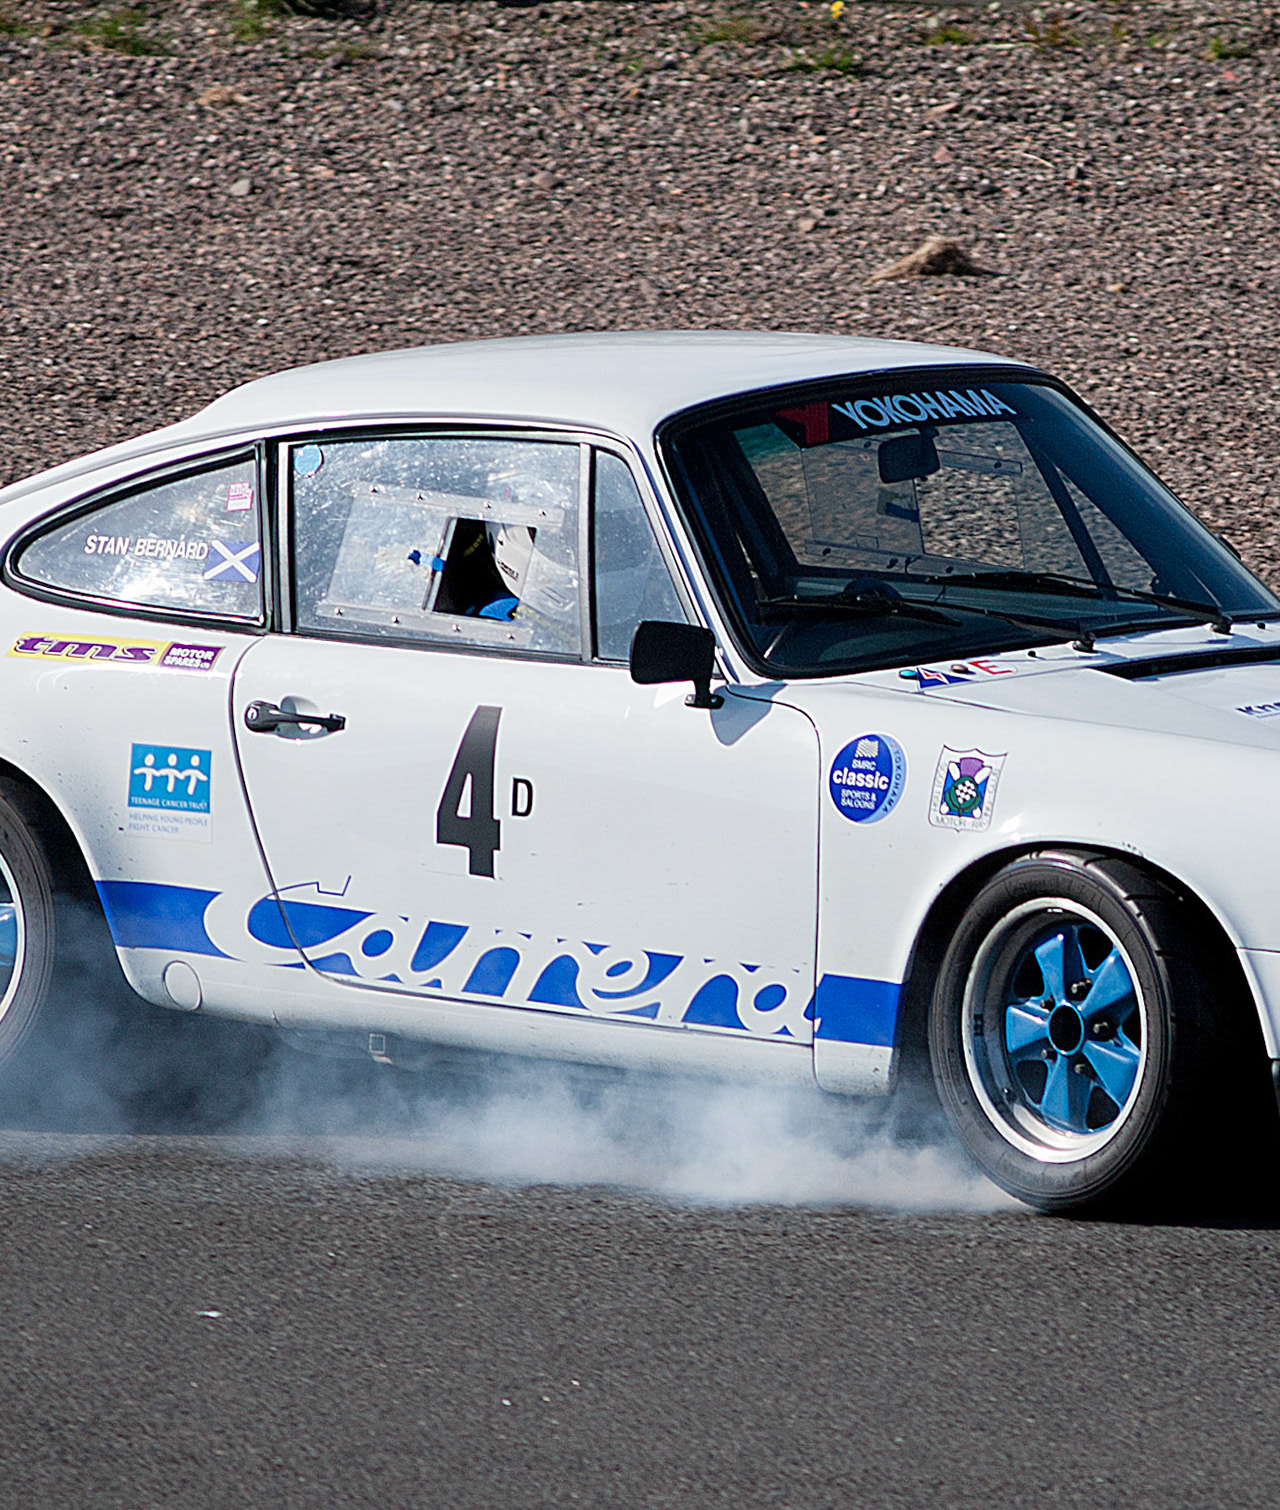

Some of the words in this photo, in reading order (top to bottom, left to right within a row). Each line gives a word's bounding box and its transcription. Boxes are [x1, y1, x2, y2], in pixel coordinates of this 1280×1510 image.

[831, 388, 1017, 430] YOKOHAMA
[84, 535, 129, 555] STAN
[134, 537, 209, 560] BERNARD
[14, 637, 157, 663] tms
[169, 647, 215, 660] MOTOR
[164, 655, 201, 668] SPARES
[852, 759, 876, 771] SMRC
[832, 767, 889, 790] classic
[882, 751, 902, 813] YOKOHAMA
[435, 705, 501, 879] 4
[511, 776, 535, 818] D
[841, 789, 870, 801] SPORTS
[131, 796, 160, 807] TEENAGE
[161, 799, 188, 808] CANCER
[189, 801, 208, 810] TRUST
[841, 798, 875, 810] SALOONS
[129, 813, 158, 822] HELPING
[185, 817, 208, 826] PEOPLE
[129, 822, 150, 831] FIGHT
[152, 824, 179, 833] CANCER
[204, 875, 821, 1036] Carrera
